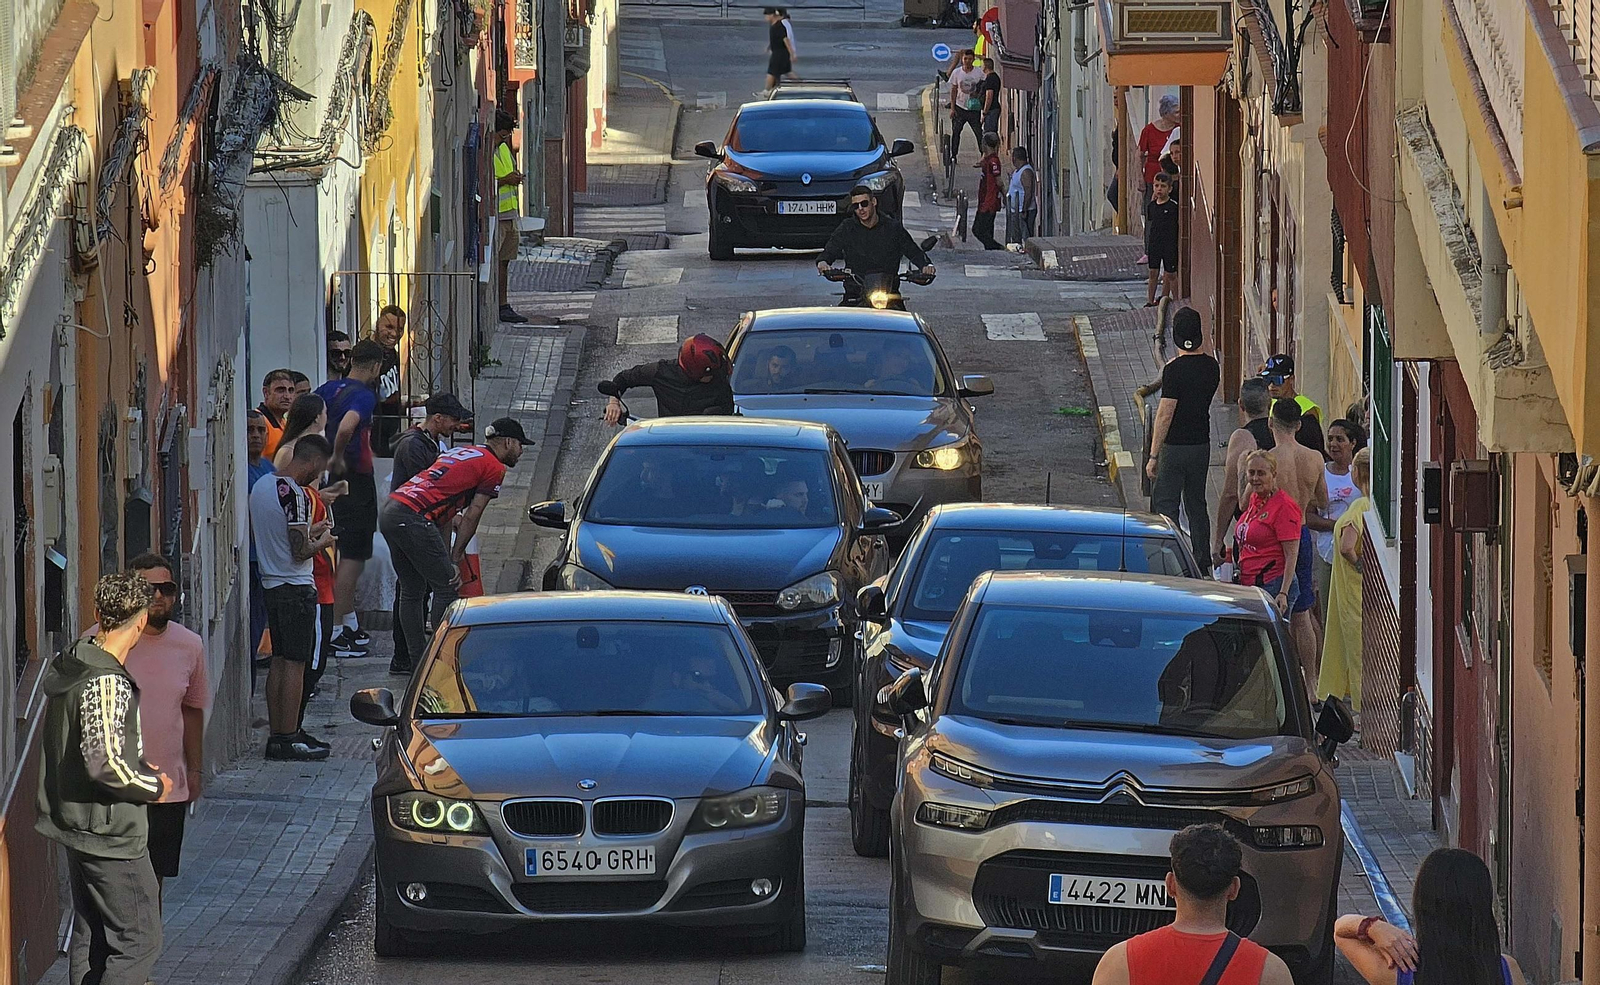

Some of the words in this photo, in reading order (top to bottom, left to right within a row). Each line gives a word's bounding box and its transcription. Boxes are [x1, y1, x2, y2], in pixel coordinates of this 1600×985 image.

[787, 203, 809, 212] 1741
[542, 850, 598, 871] 6540
[607, 849, 649, 870] GRH
[1067, 879, 1127, 904] 4422
[1135, 883, 1172, 907] MN
